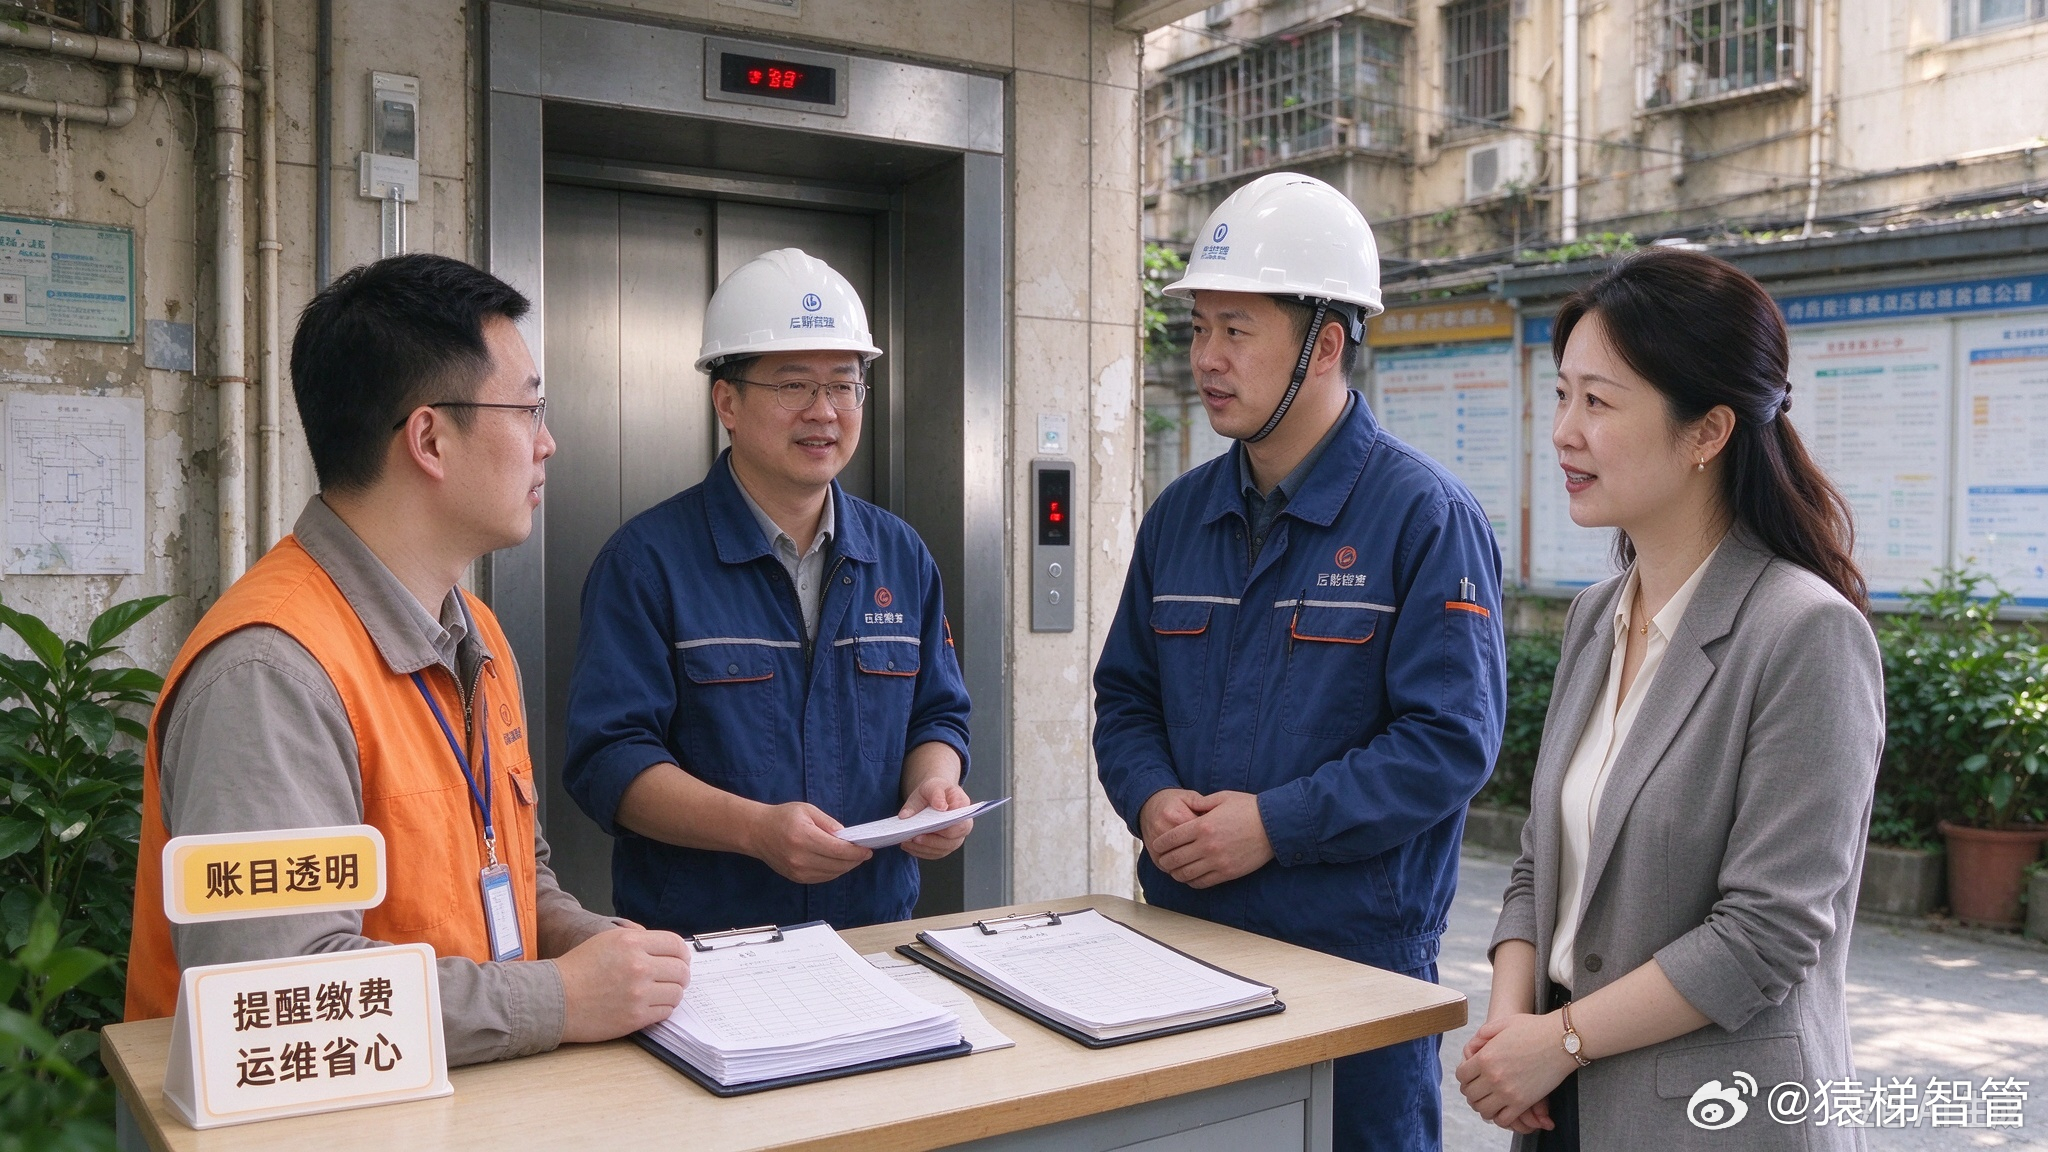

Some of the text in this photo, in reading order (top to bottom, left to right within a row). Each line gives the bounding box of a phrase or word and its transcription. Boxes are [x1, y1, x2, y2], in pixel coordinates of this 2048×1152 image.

[205, 853, 359, 899] 账目透明
[233, 977, 393, 1032] 提醒缴费
[236, 1032, 403, 1089] 运维省心
